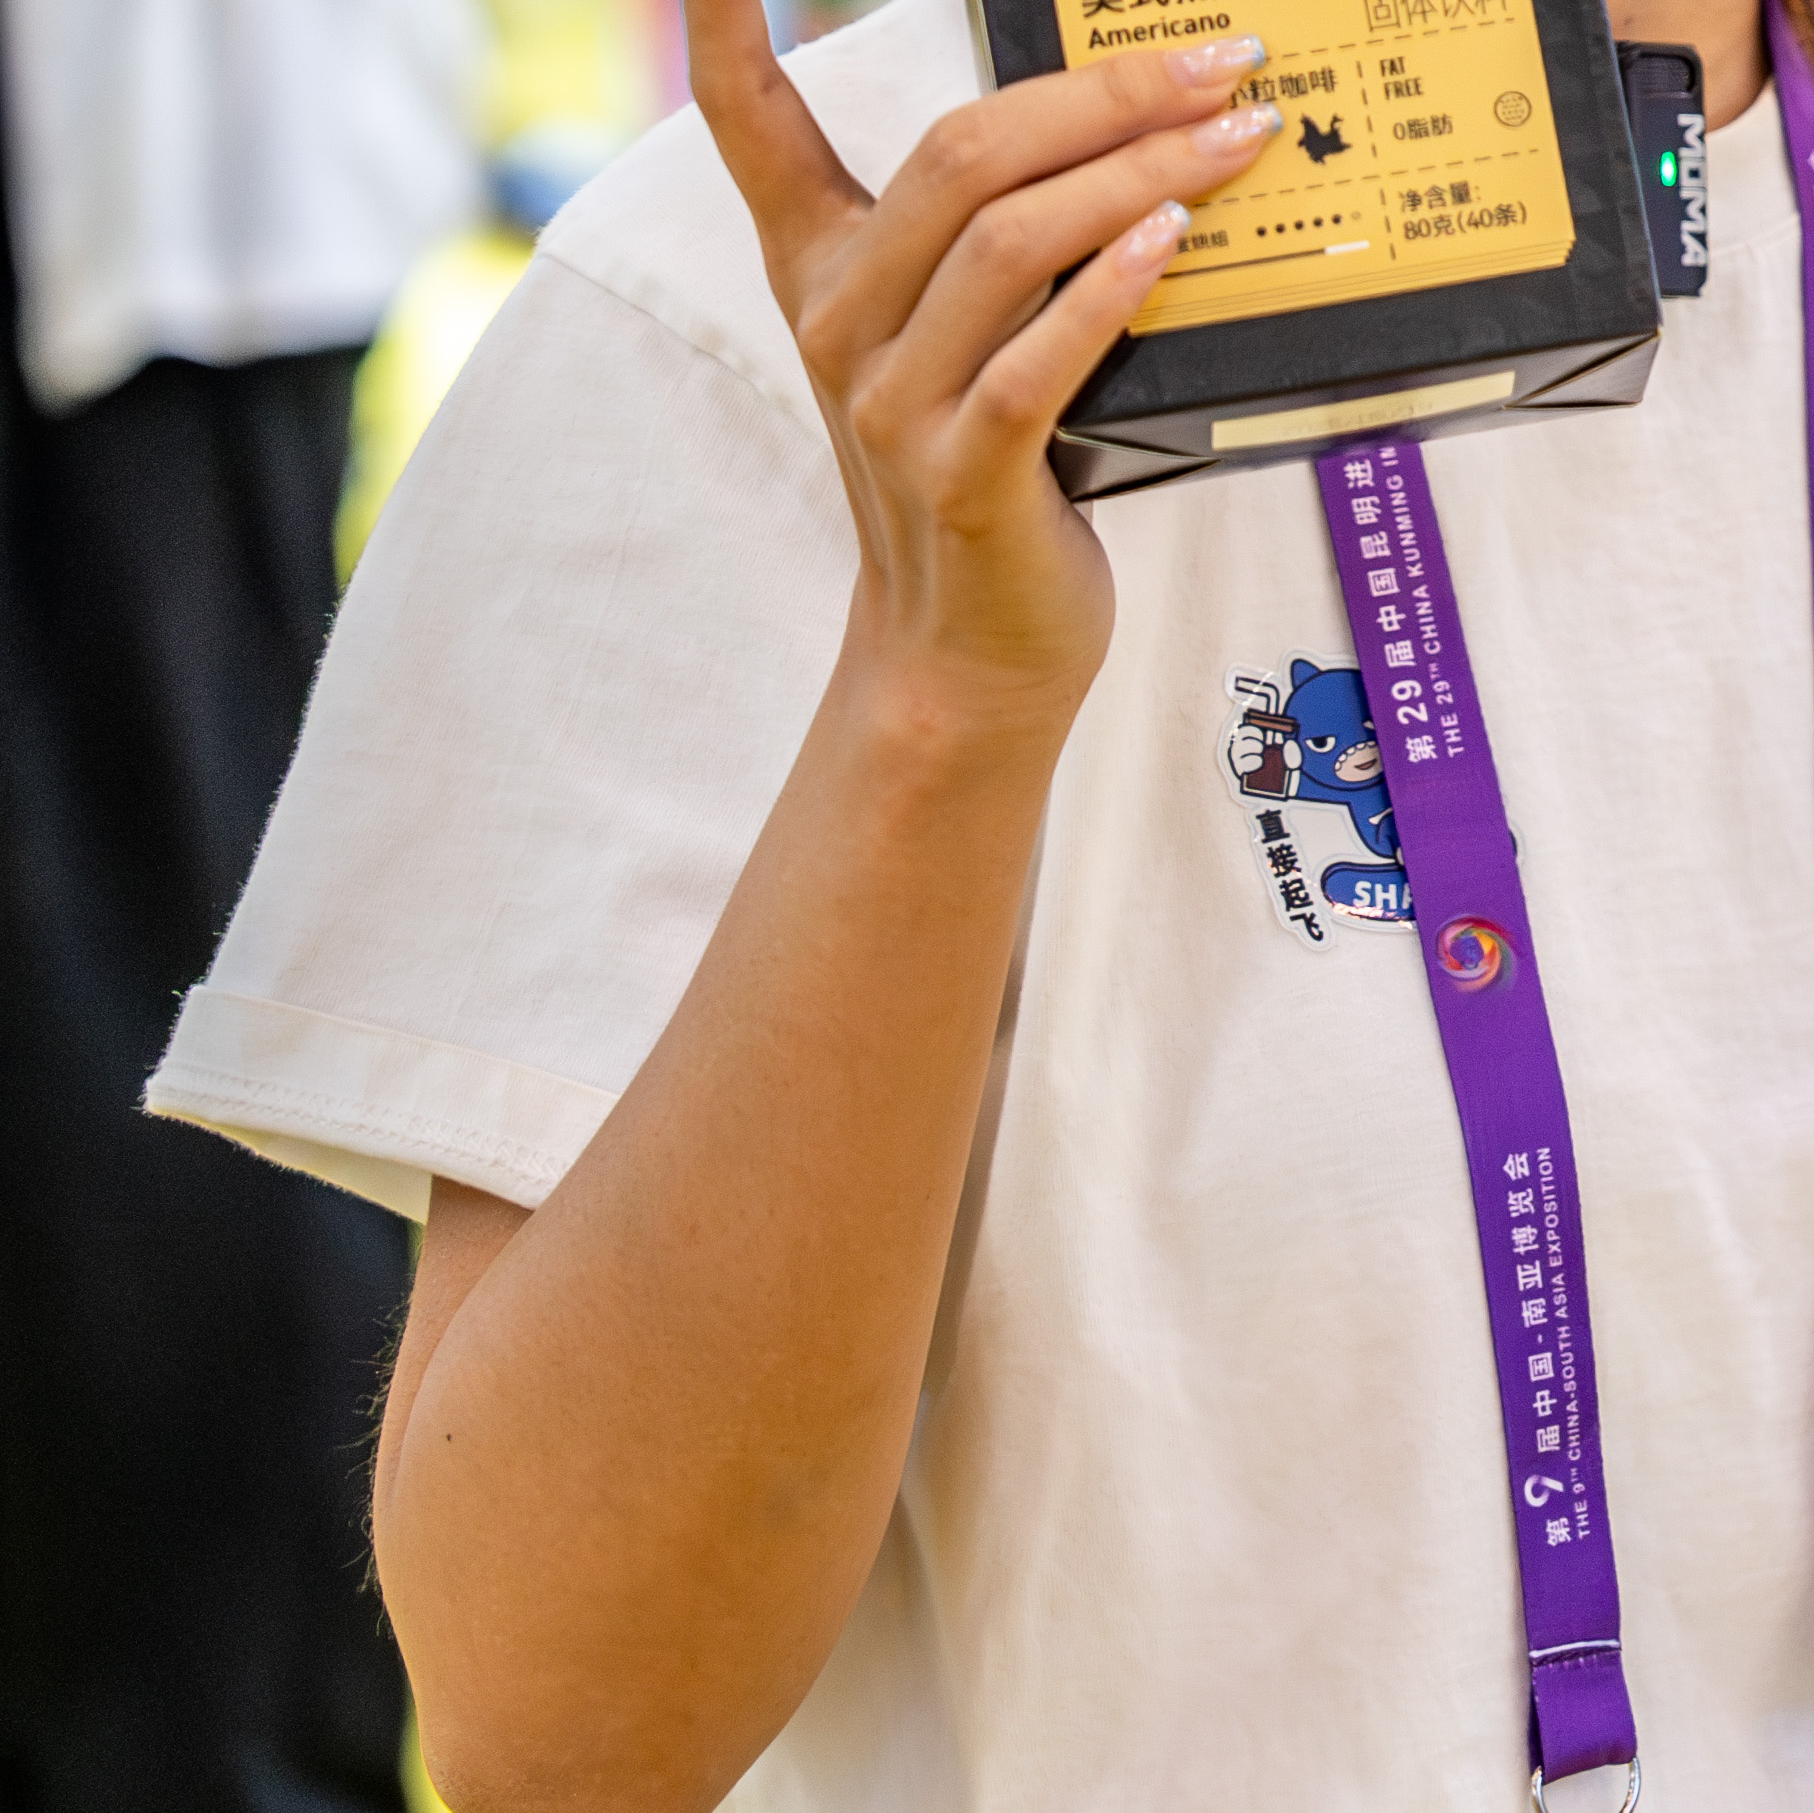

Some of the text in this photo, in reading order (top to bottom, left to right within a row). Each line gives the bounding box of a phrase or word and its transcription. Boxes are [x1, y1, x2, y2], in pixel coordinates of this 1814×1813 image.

[1088, 12, 1232, 50] Americano
[1380, 55, 1406, 78] FAT
[1384, 77, 1424, 101] FREE
[1393, 114, 1454, 141] 0脂肪
[1676, 112, 1709, 269] MOMA
[1404, 201, 1528, 241] 80克(40条)
[1386, 474, 1424, 579] KUNMING
[1412, 584, 1441, 656] CHINA
[1440, 713, 1466, 759] THE
[1255, 809, 1325, 942] 直接起飞
[1536, 1147, 1564, 1267] EXPOSITION
[1550, 1273, 1568, 1319] ASIA
[1556, 1326, 1581, 1461] CHINA-SOUTH
[1574, 1501, 1591, 1540] THE
